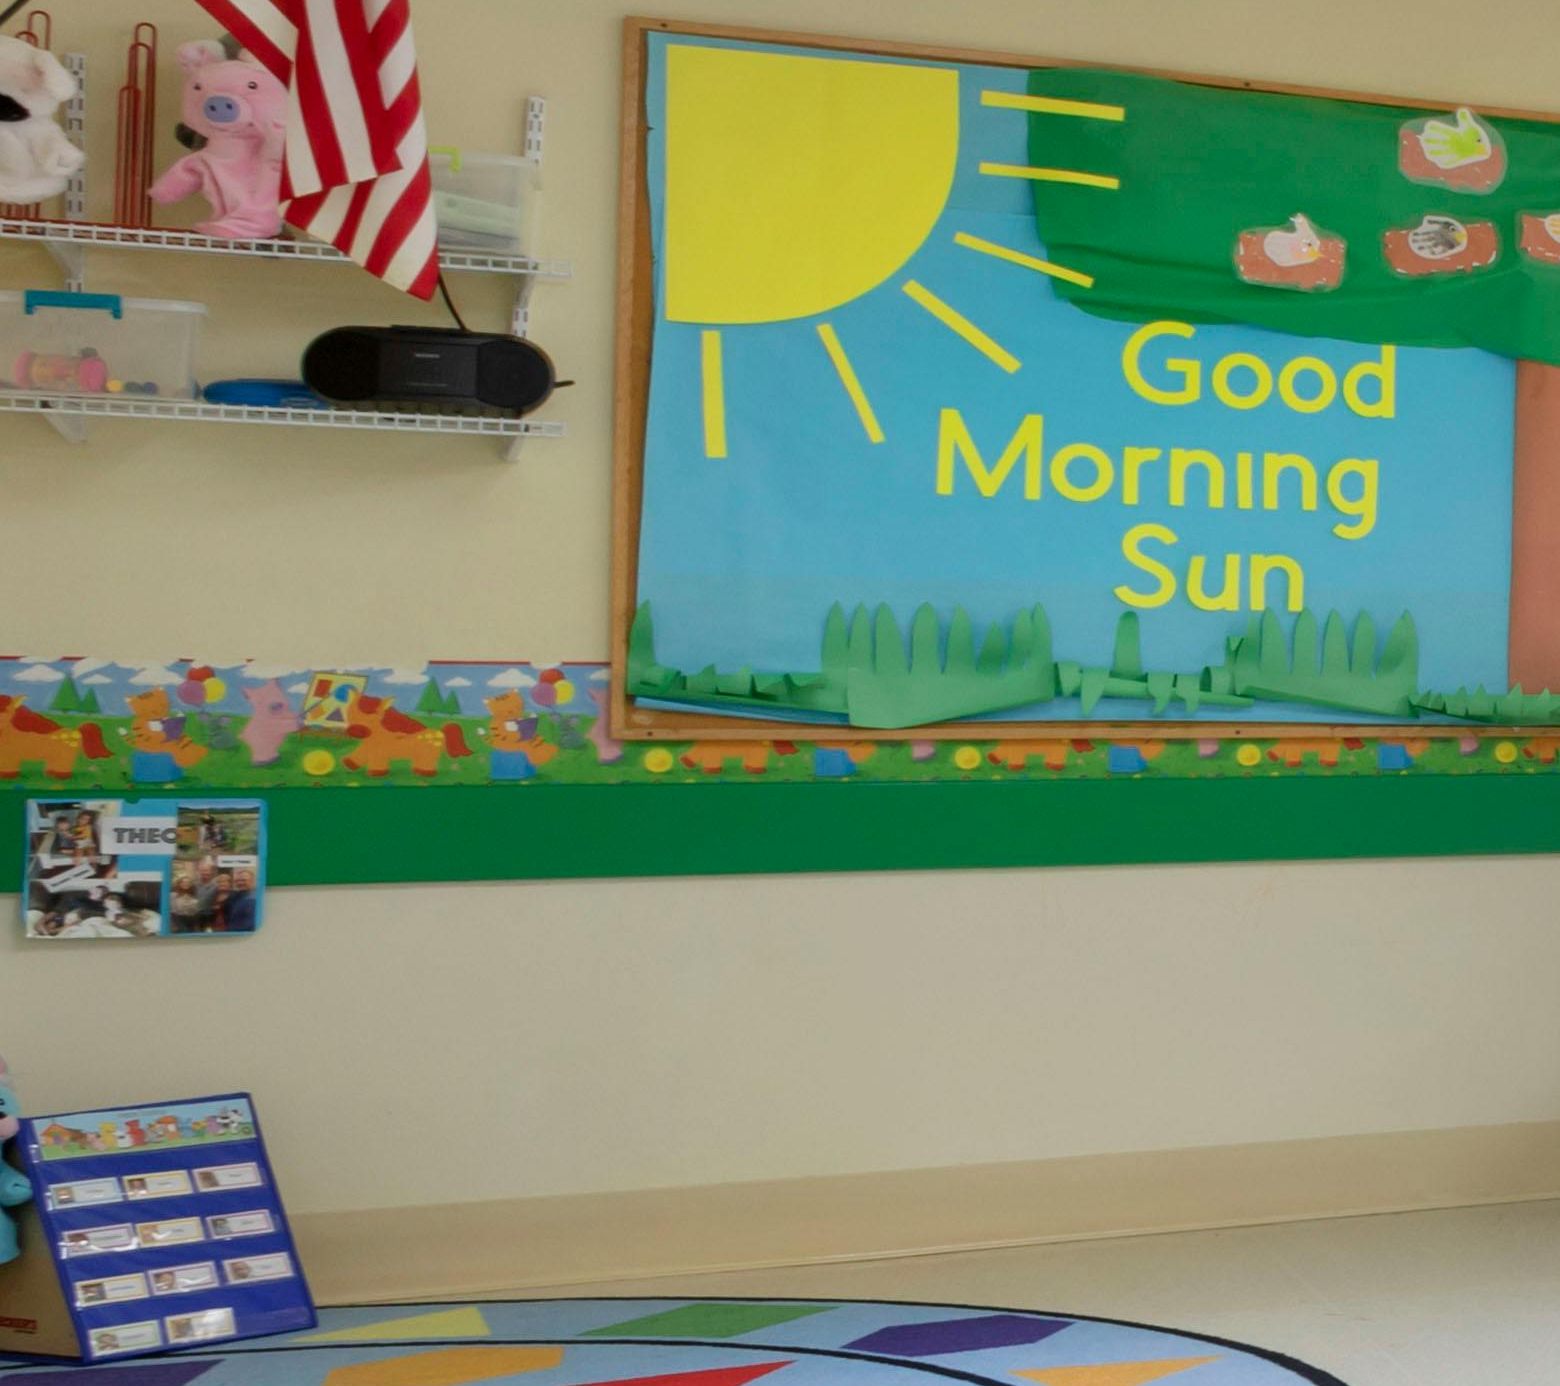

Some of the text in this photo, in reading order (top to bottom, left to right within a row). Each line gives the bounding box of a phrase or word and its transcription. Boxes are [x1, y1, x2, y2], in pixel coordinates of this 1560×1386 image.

[1121, 320, 1395, 419] Good
[936, 408, 1379, 540] Morning
[1113, 523, 1304, 613] Sun
